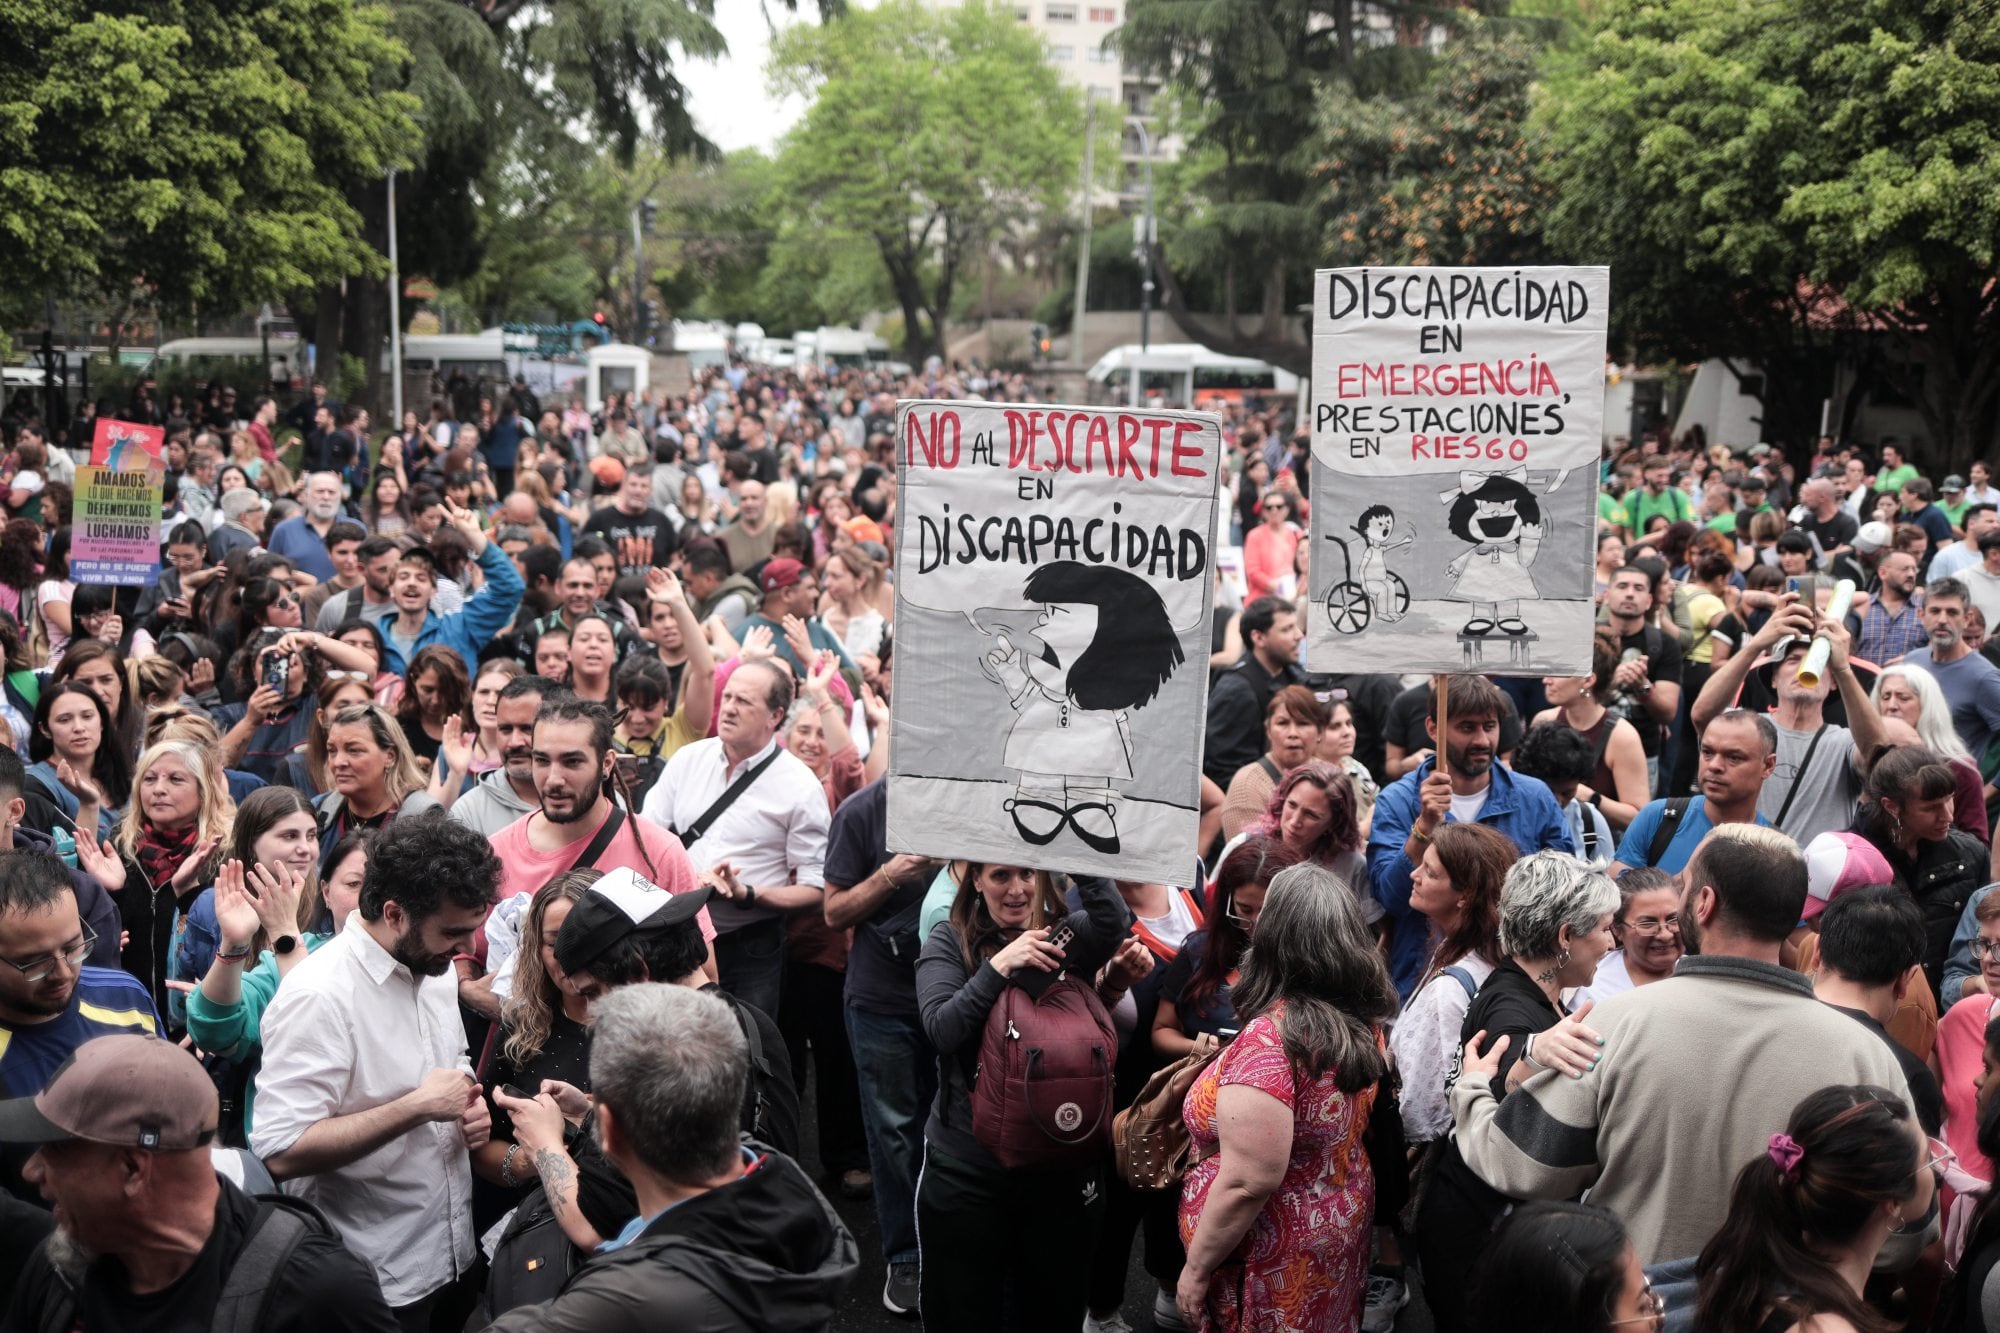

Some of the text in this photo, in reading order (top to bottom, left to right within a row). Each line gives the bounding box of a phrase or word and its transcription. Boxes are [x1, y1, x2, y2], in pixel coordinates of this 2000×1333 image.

[1420, 324, 1463, 354] EN
[1317, 402, 1565, 436] PRESTACIONES
[907, 410, 1207, 481] NO AL DESCARTE
[1350, 434, 1528, 461] EN RIESGO
[94, 471, 146, 488] AMAMOS
[1018, 476, 1053, 500] EN
[88, 486, 152, 501] LO QUE HACEMOS
[87, 501, 152, 517] DEFENDEMOS
[87, 523, 150, 540] LUCHAMOS
[76, 561, 152, 573] PERO NO SE PUEDE
[82, 573, 145, 585] VIVIR DEL AMOR
